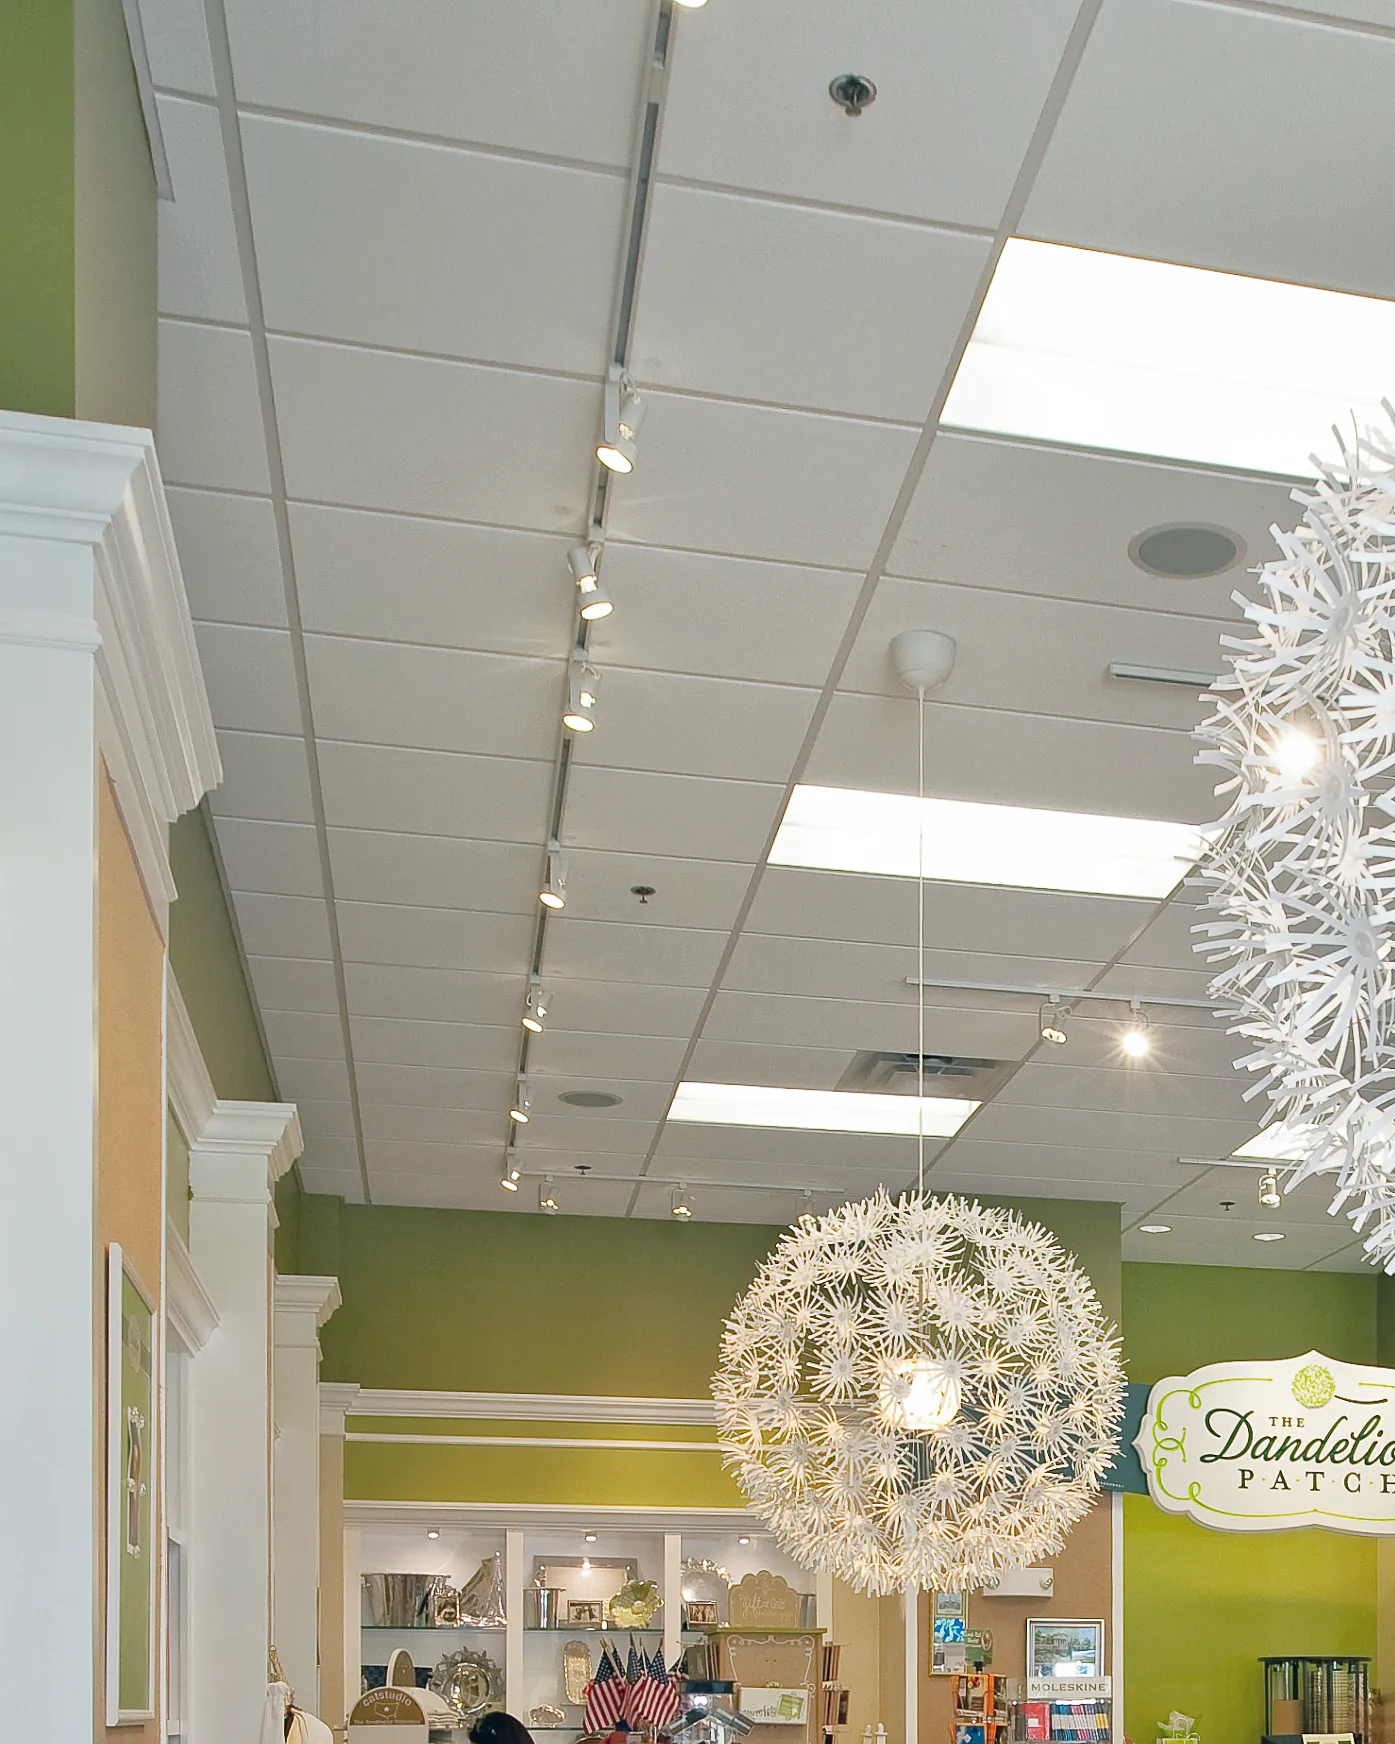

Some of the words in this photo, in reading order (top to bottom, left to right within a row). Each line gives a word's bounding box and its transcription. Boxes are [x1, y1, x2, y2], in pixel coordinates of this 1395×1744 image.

[1269, 1416, 1306, 1429] THE
[1031, 1683, 1106, 1693] MOLESKINE
[362, 1690, 412, 1707] catstudio
